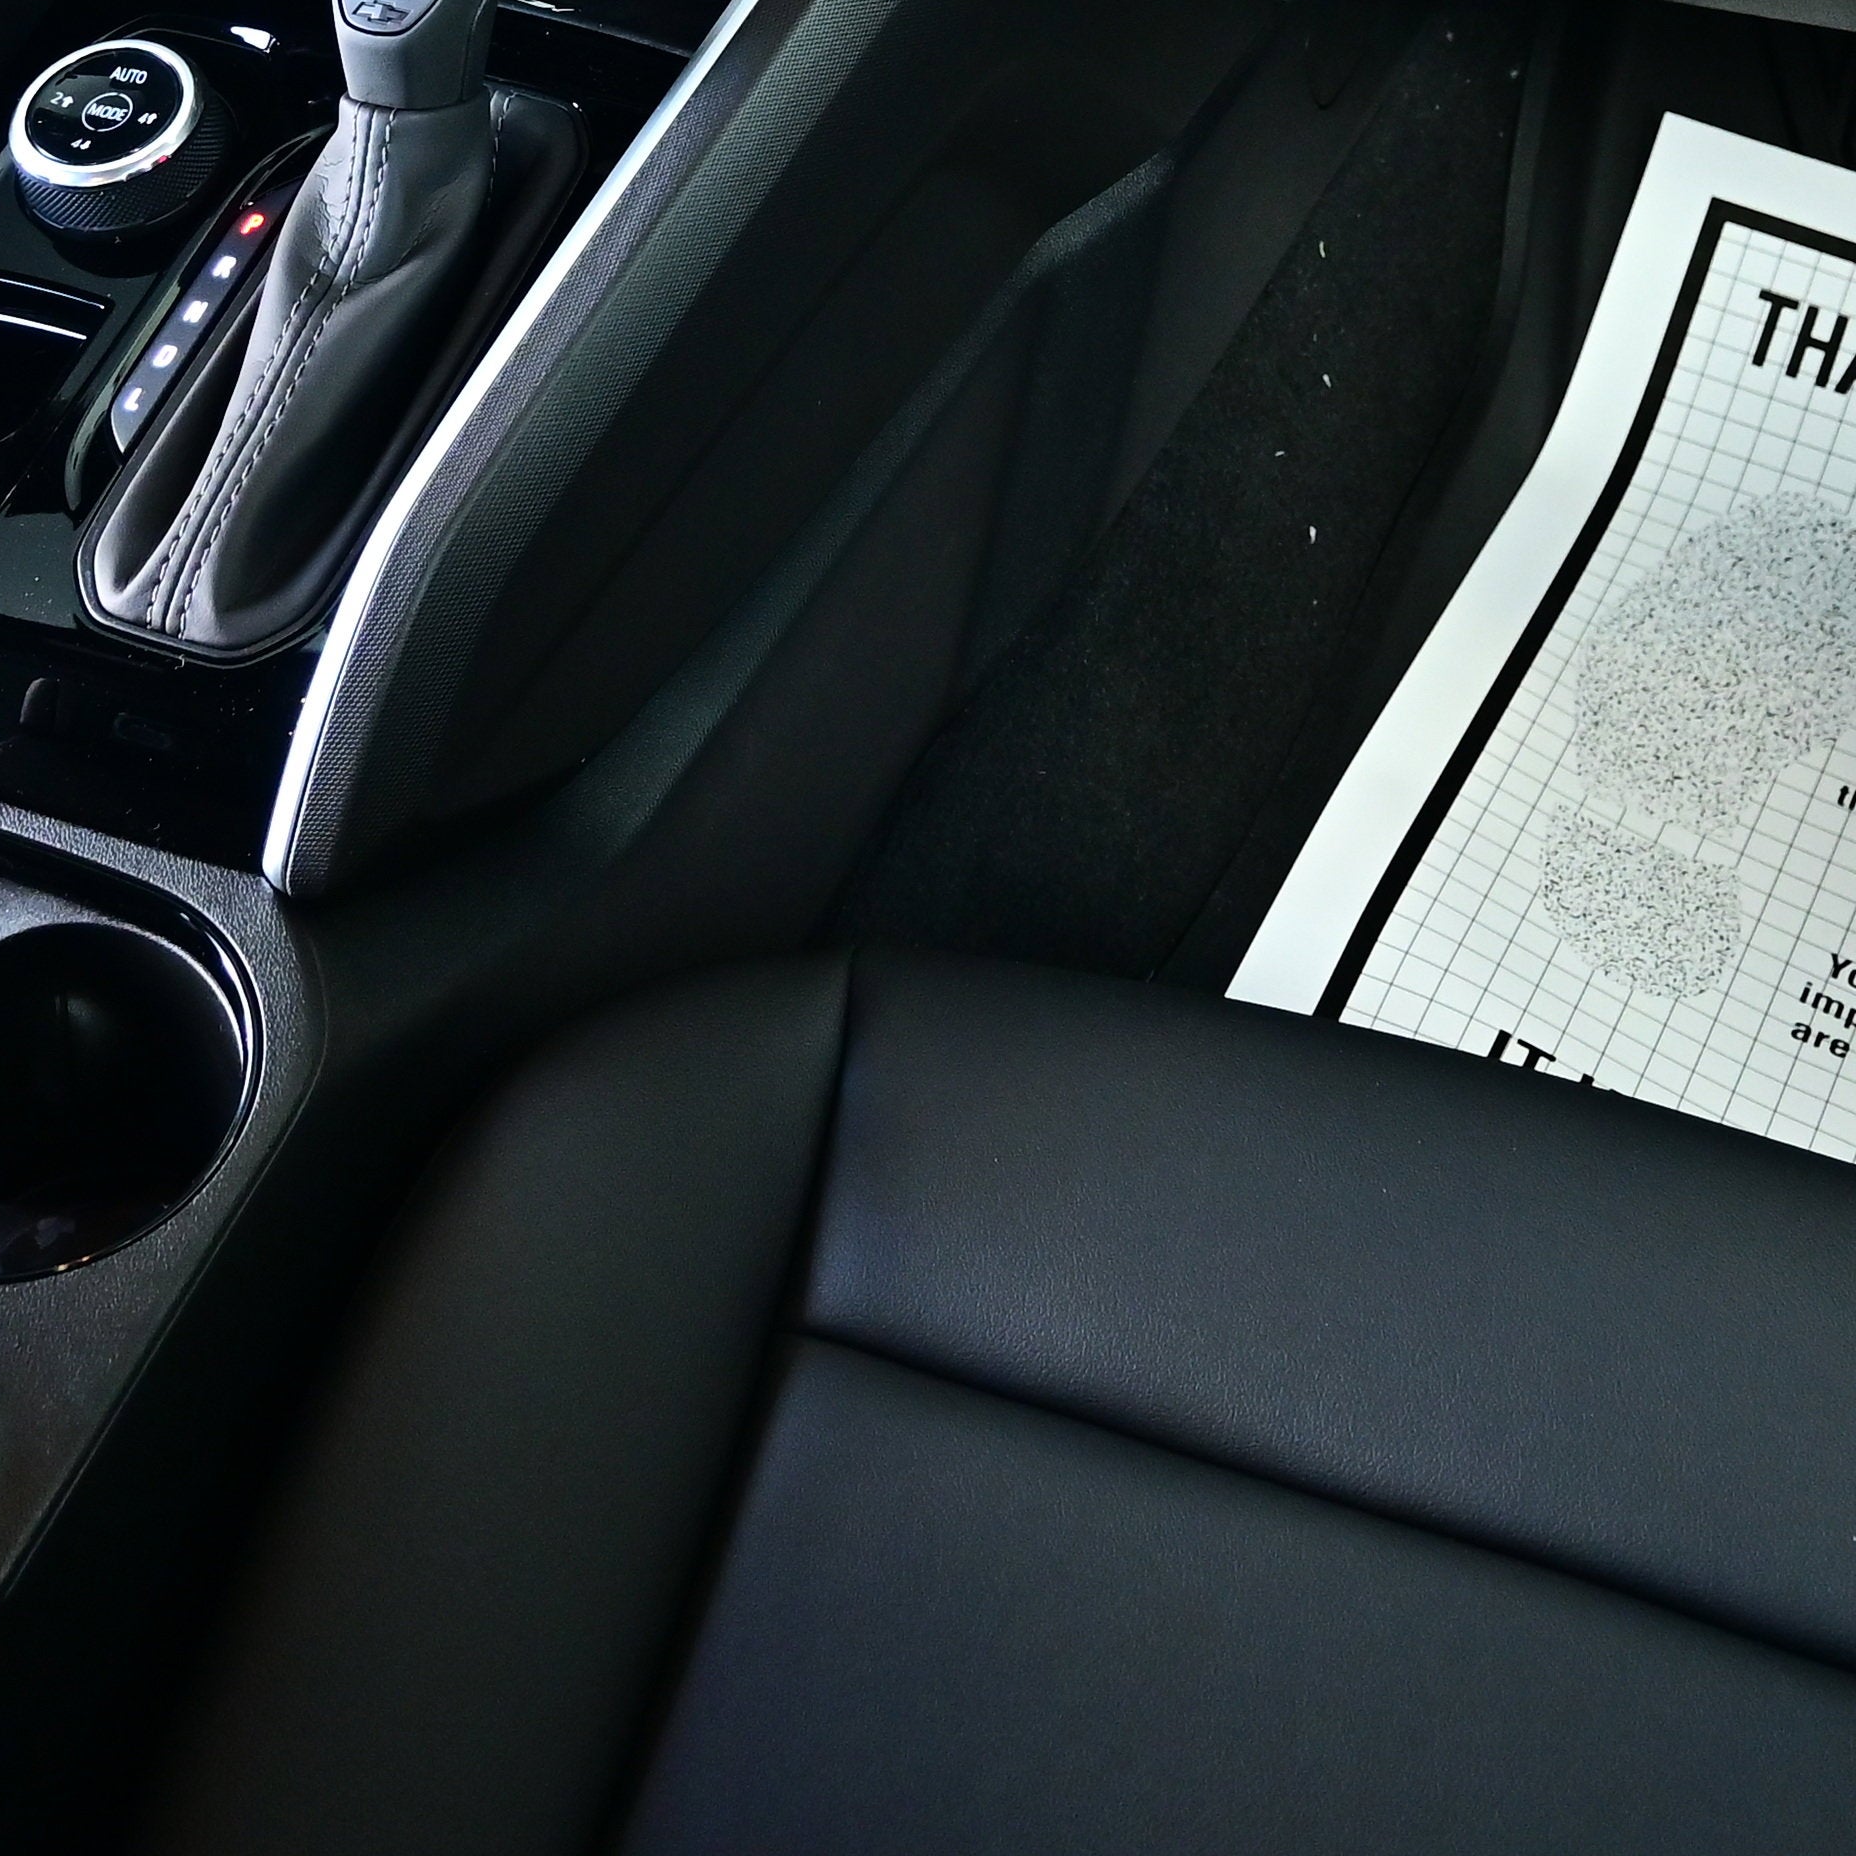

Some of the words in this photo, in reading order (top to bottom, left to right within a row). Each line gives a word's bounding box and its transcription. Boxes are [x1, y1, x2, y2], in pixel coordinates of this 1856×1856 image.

[109, 66, 148, 85] AUTO
[87, 103, 129, 122] MODE
[240, 213, 265, 235] P
[212, 255, 237, 279] R
[182, 300, 209, 323] N
[152, 344, 178, 369] D
[123, 387, 143, 412] L
[1789, 1021, 1851, 1059] are
